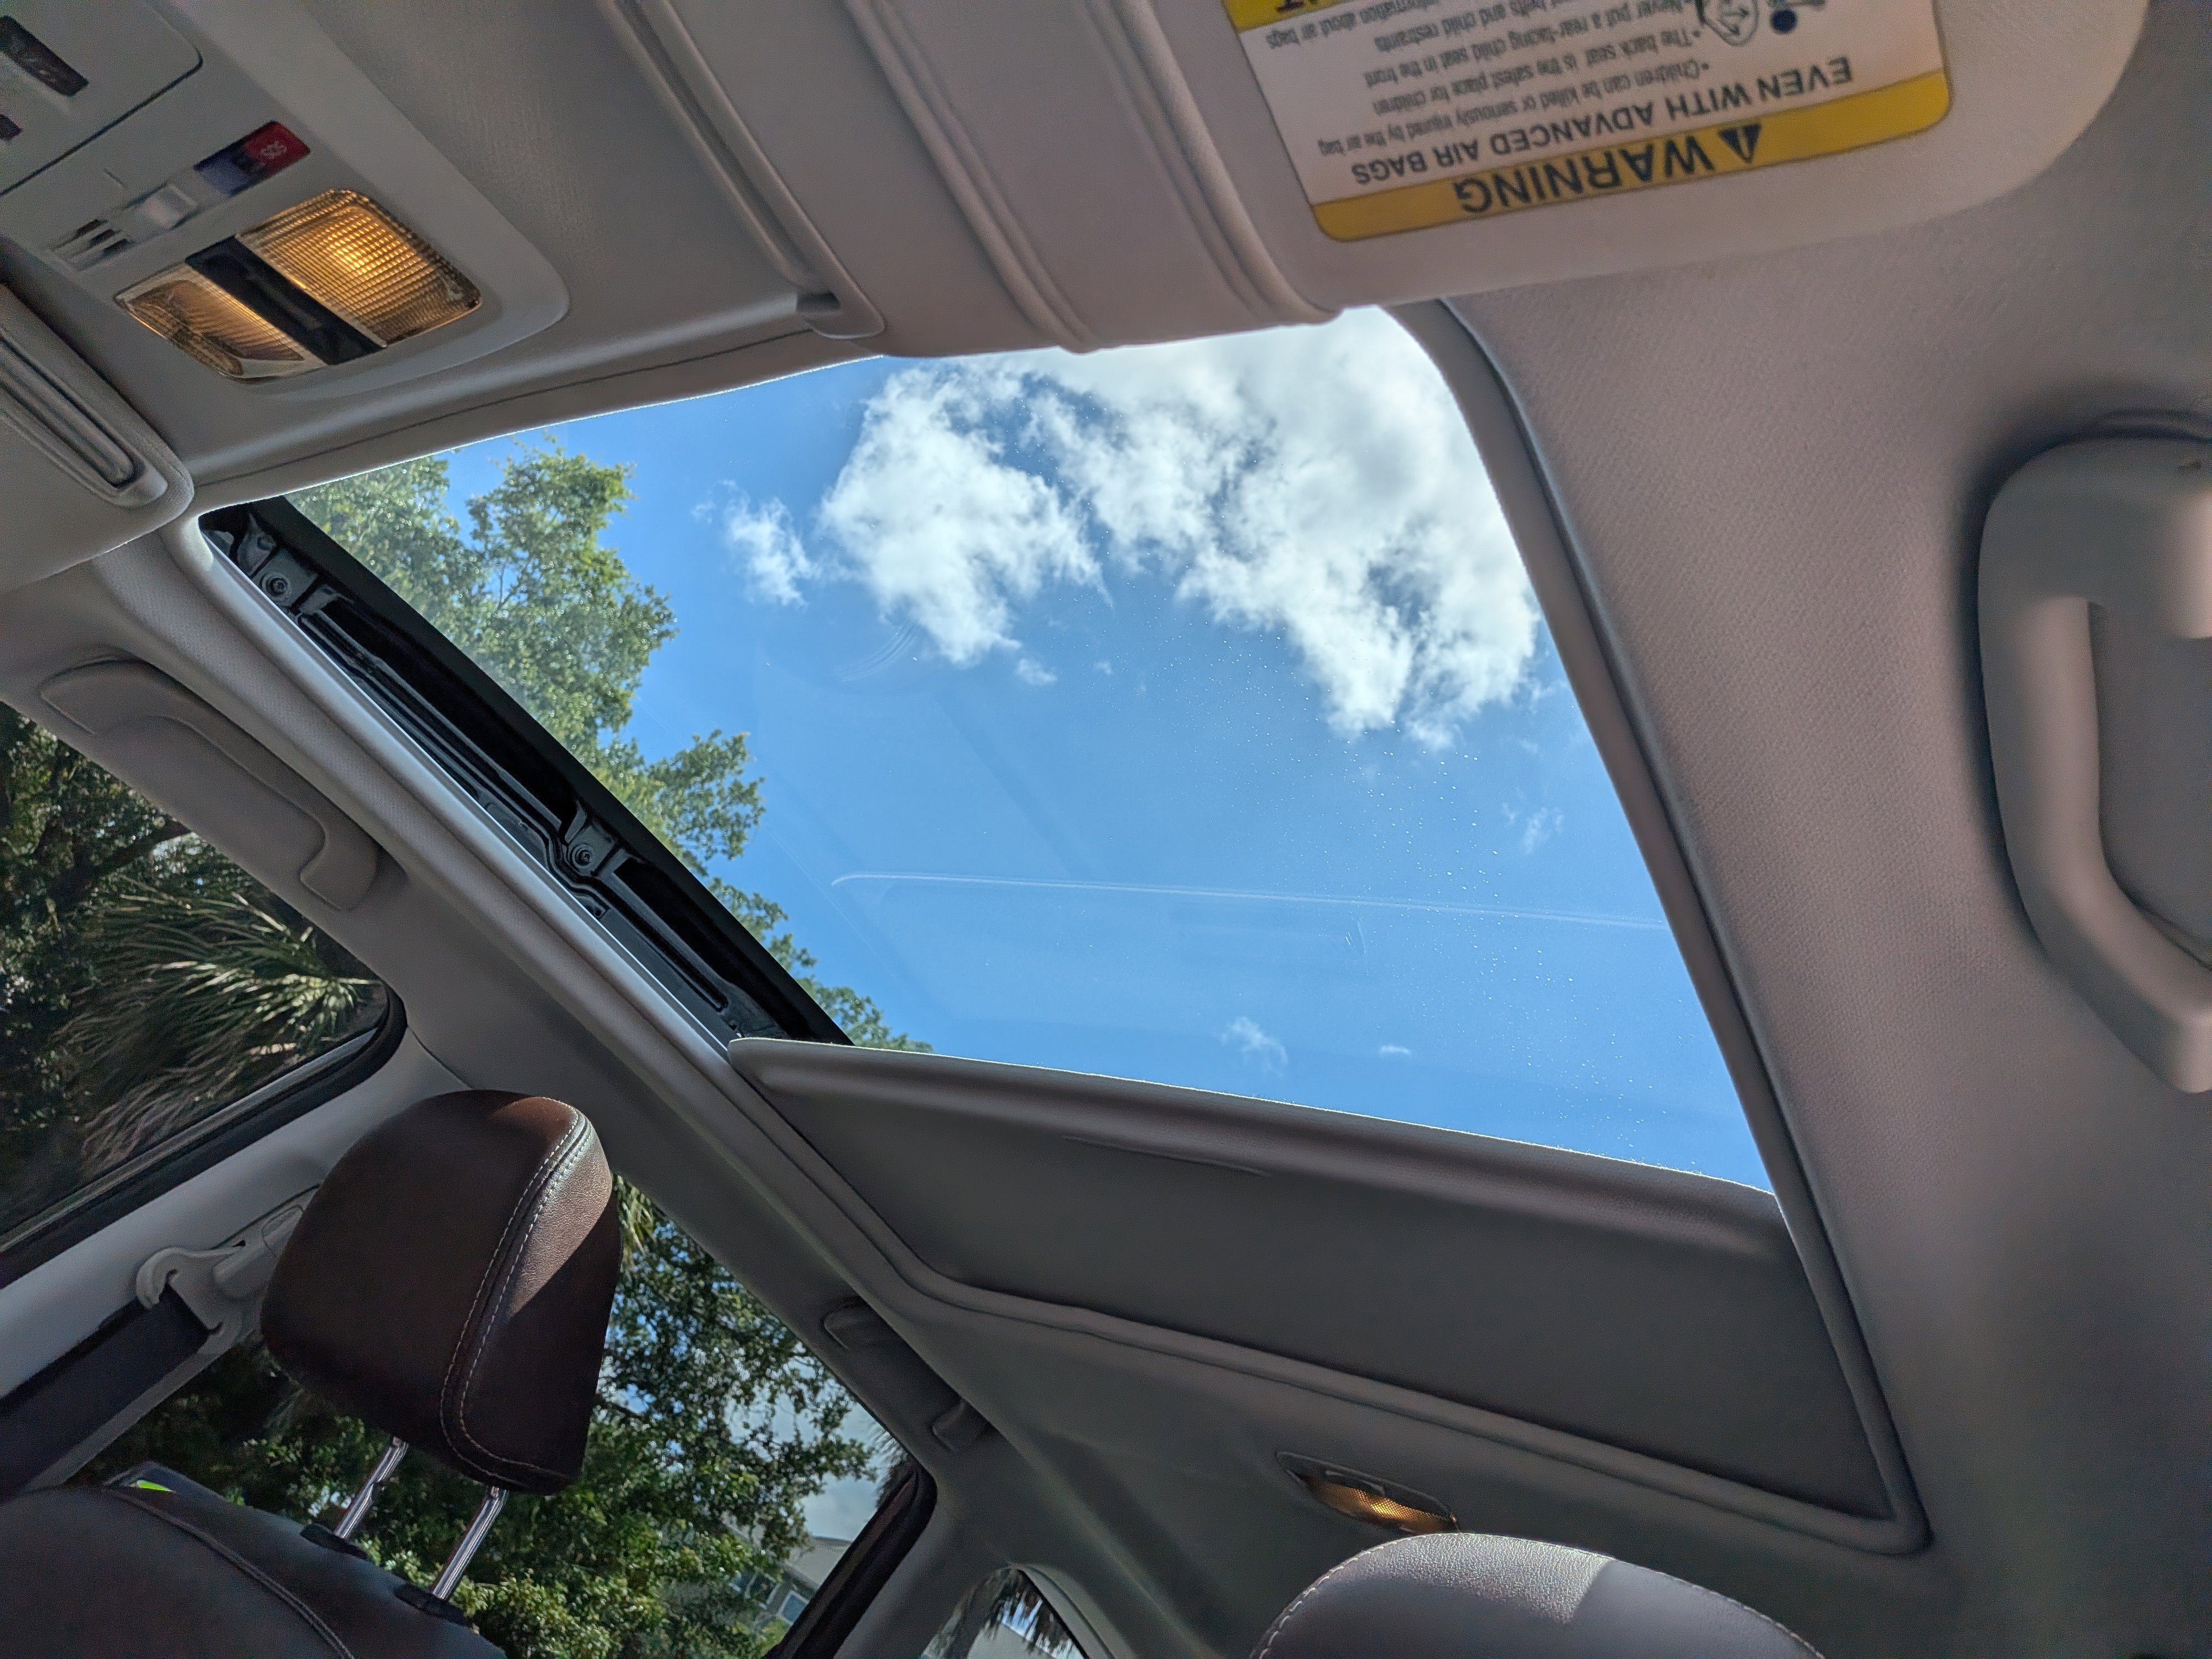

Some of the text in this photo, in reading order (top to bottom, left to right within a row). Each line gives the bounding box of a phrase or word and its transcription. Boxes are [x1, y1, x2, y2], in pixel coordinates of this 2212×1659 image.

[1319, 12, 1356, 36] about
[1441, 12, 1476, 35] child
[1478, 3, 1506, 27] and
[1590, 12, 1601, 29] a
[1605, 2, 1632, 28] put
[1266, 28, 1300, 49] bags
[1507, 18, 1588, 50] rear-facing
[1439, 47, 1469, 69] seat
[1470, 38, 1506, 61] child
[1373, 28, 1692, 115] The back seat is the safest place for children
[1399, 61, 1422, 77] the
[1422, 56, 1438, 71] in
[1364, 67, 1398, 88] front
[1317, 58, 1700, 155] Children can be killed or seriously injured by the air bag
[1351, 56, 1853, 185] EVEN WITH ADVANCED AIR BAGS
[1455, 136, 1713, 212] WARNING
